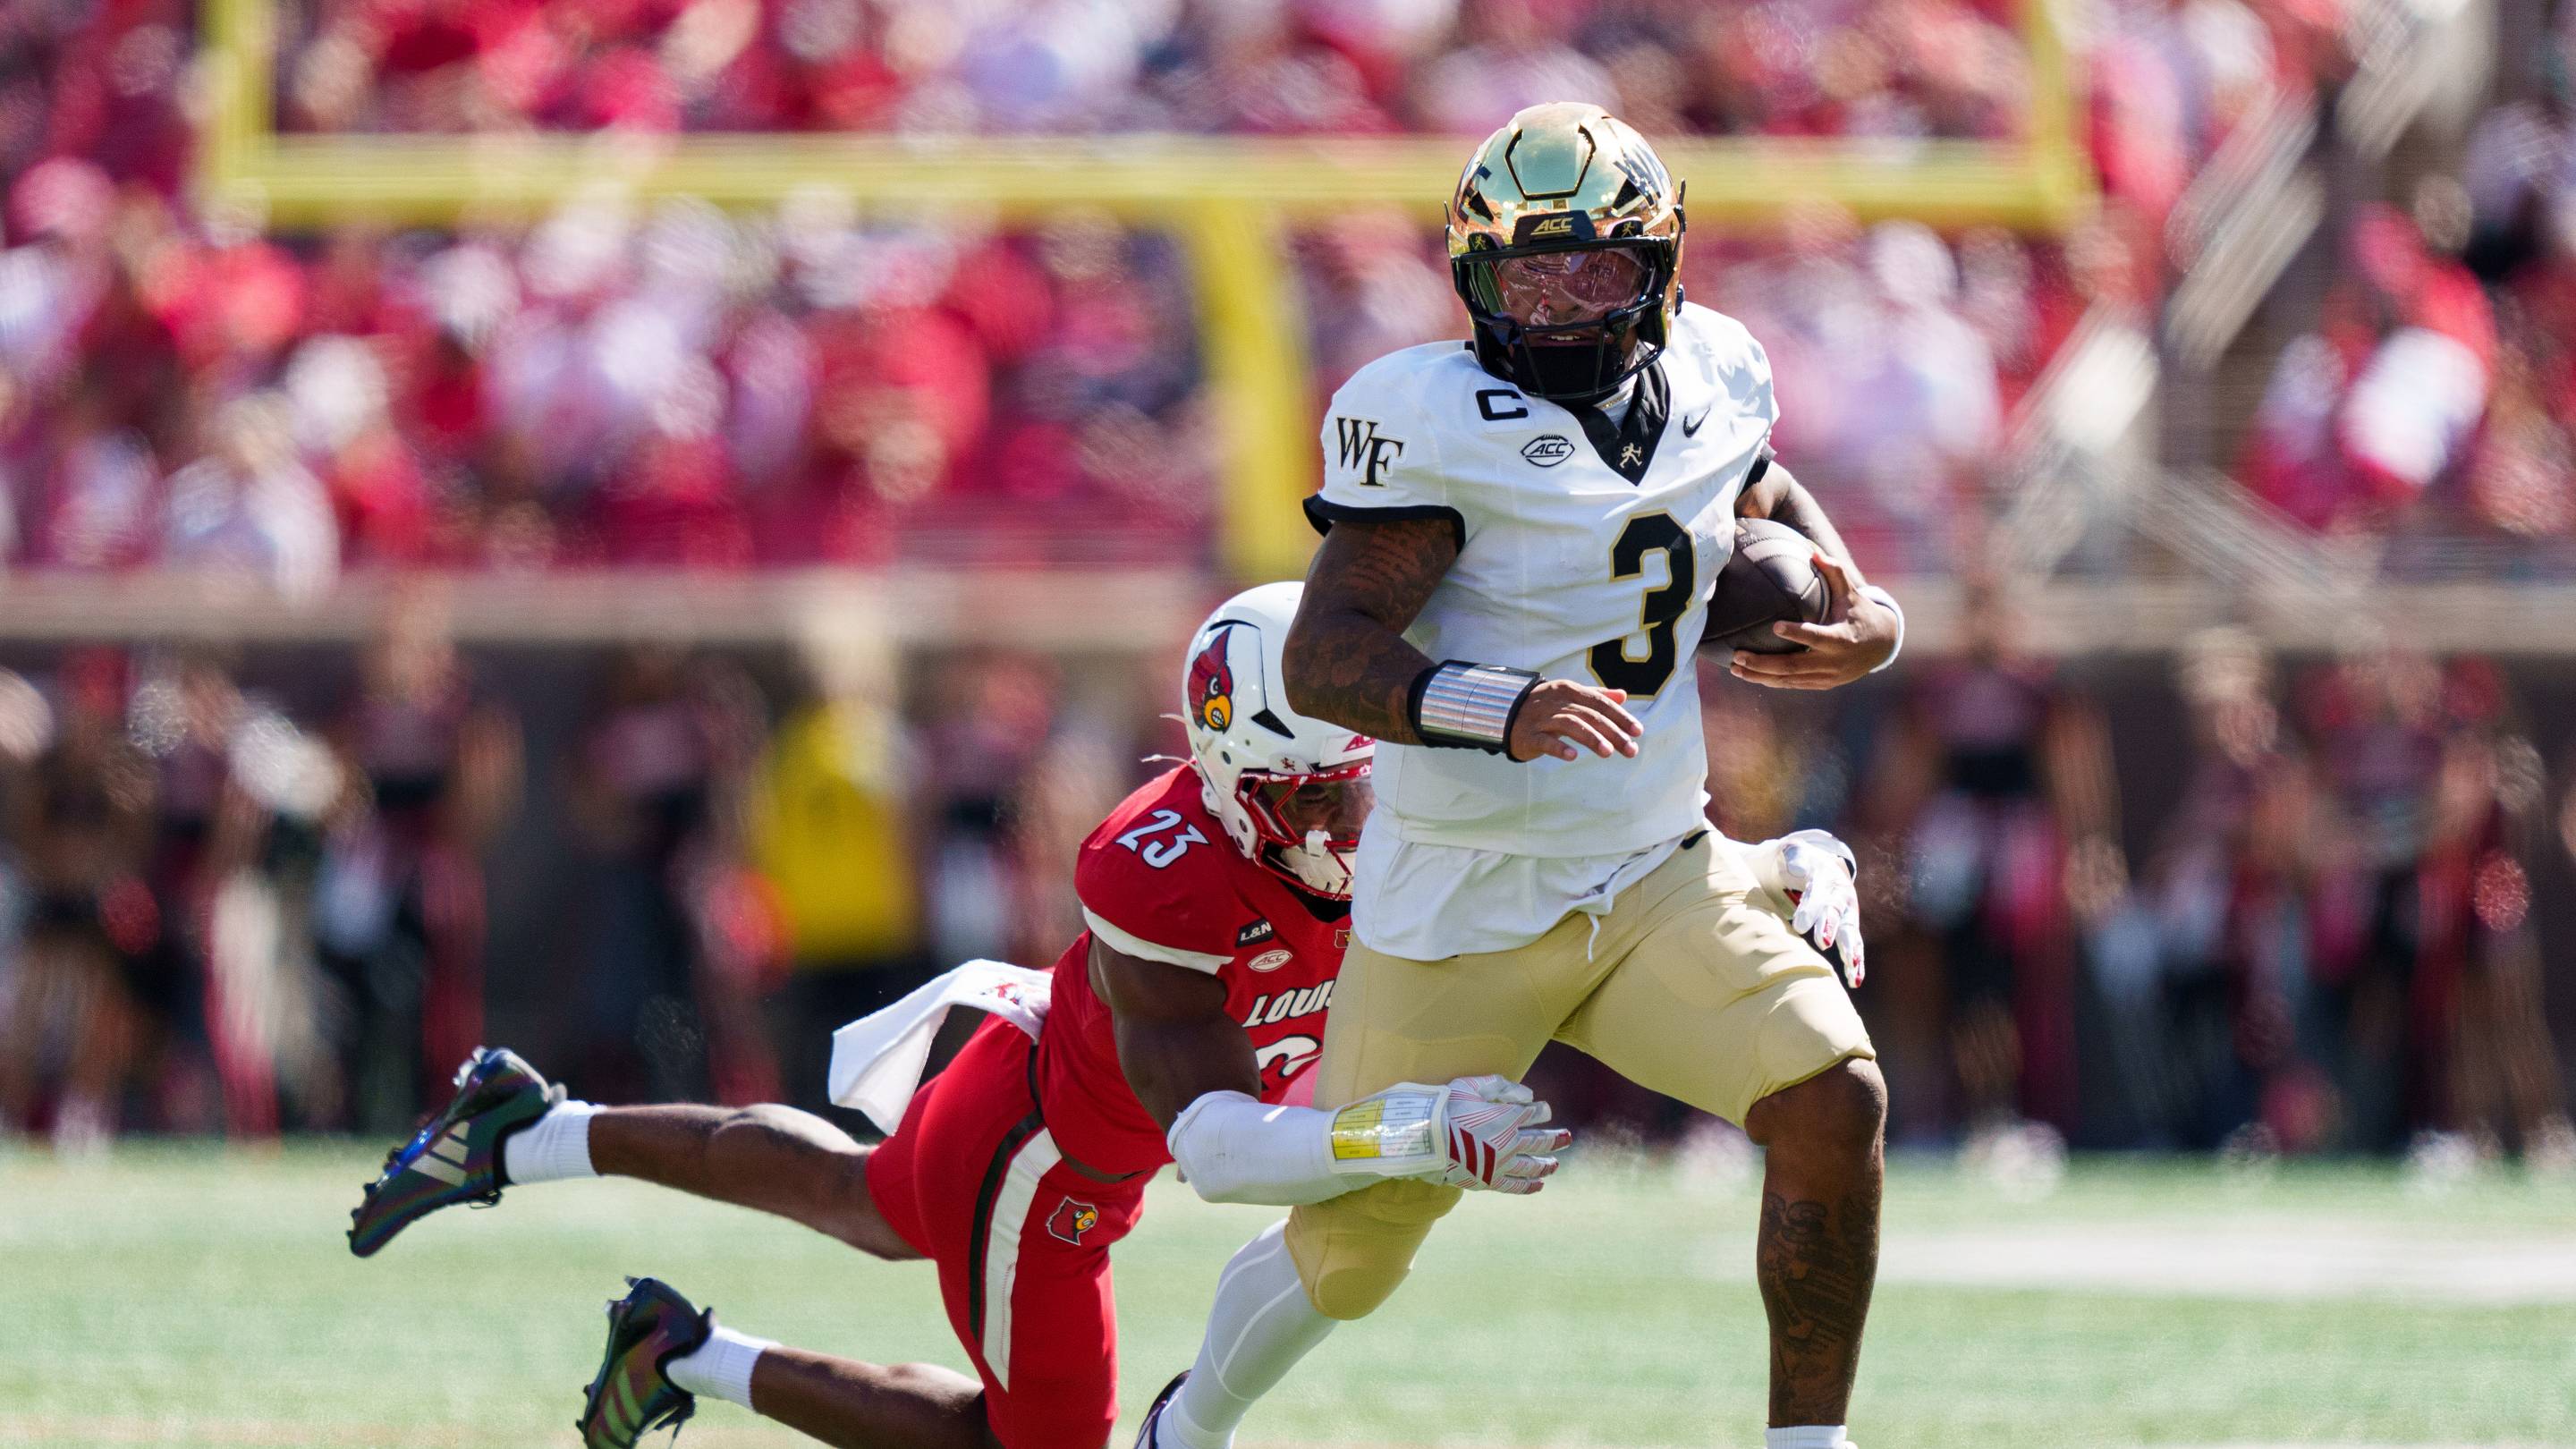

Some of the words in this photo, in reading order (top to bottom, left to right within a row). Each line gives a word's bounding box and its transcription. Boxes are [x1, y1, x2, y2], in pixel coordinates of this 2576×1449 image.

[1531, 217, 1573, 234] ACC
[1476, 389, 1529, 421] C
[1336, 417, 1404, 487] WF
[1527, 443, 1568, 457] ACC
[1586, 508, 1697, 701] 3
[1114, 809, 1211, 869] 23
[1241, 921, 1272, 941] L&N
